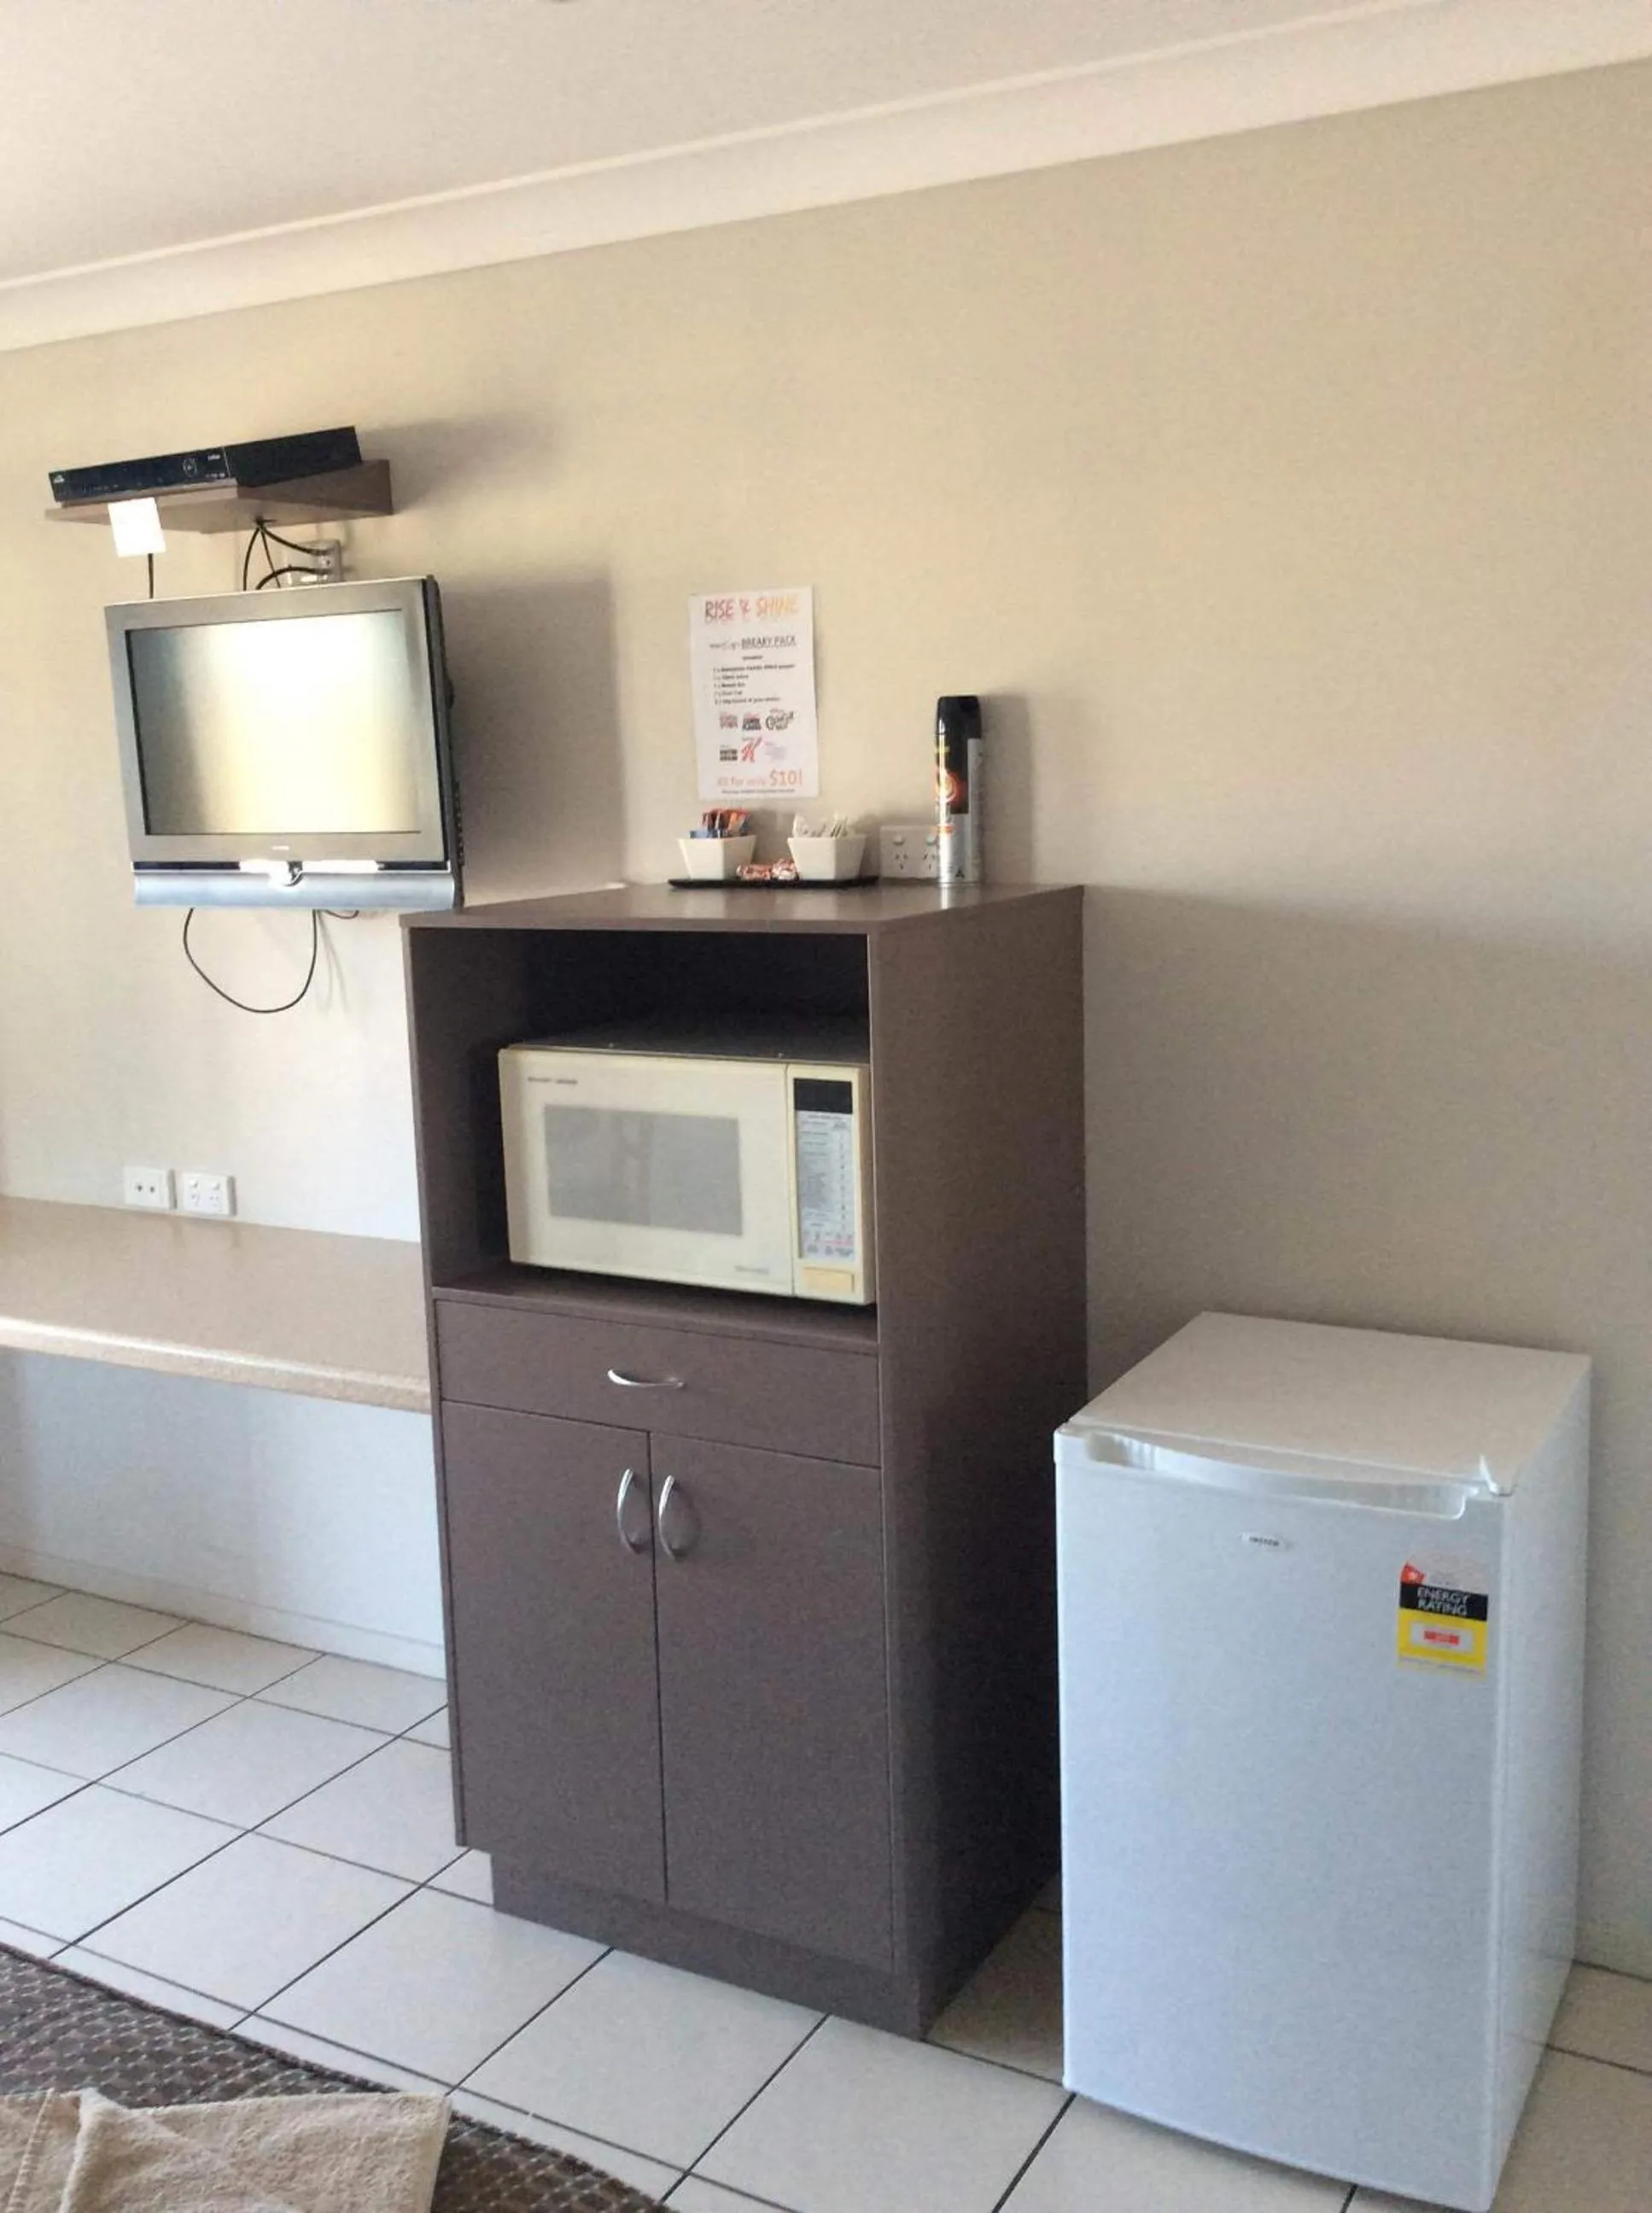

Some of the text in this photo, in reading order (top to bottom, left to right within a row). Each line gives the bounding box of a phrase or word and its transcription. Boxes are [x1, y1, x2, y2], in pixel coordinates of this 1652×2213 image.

[705, 599, 734, 620] RISE
[770, 768, 803, 786] $10!
[1417, 1586, 1470, 1604] ENERGY
